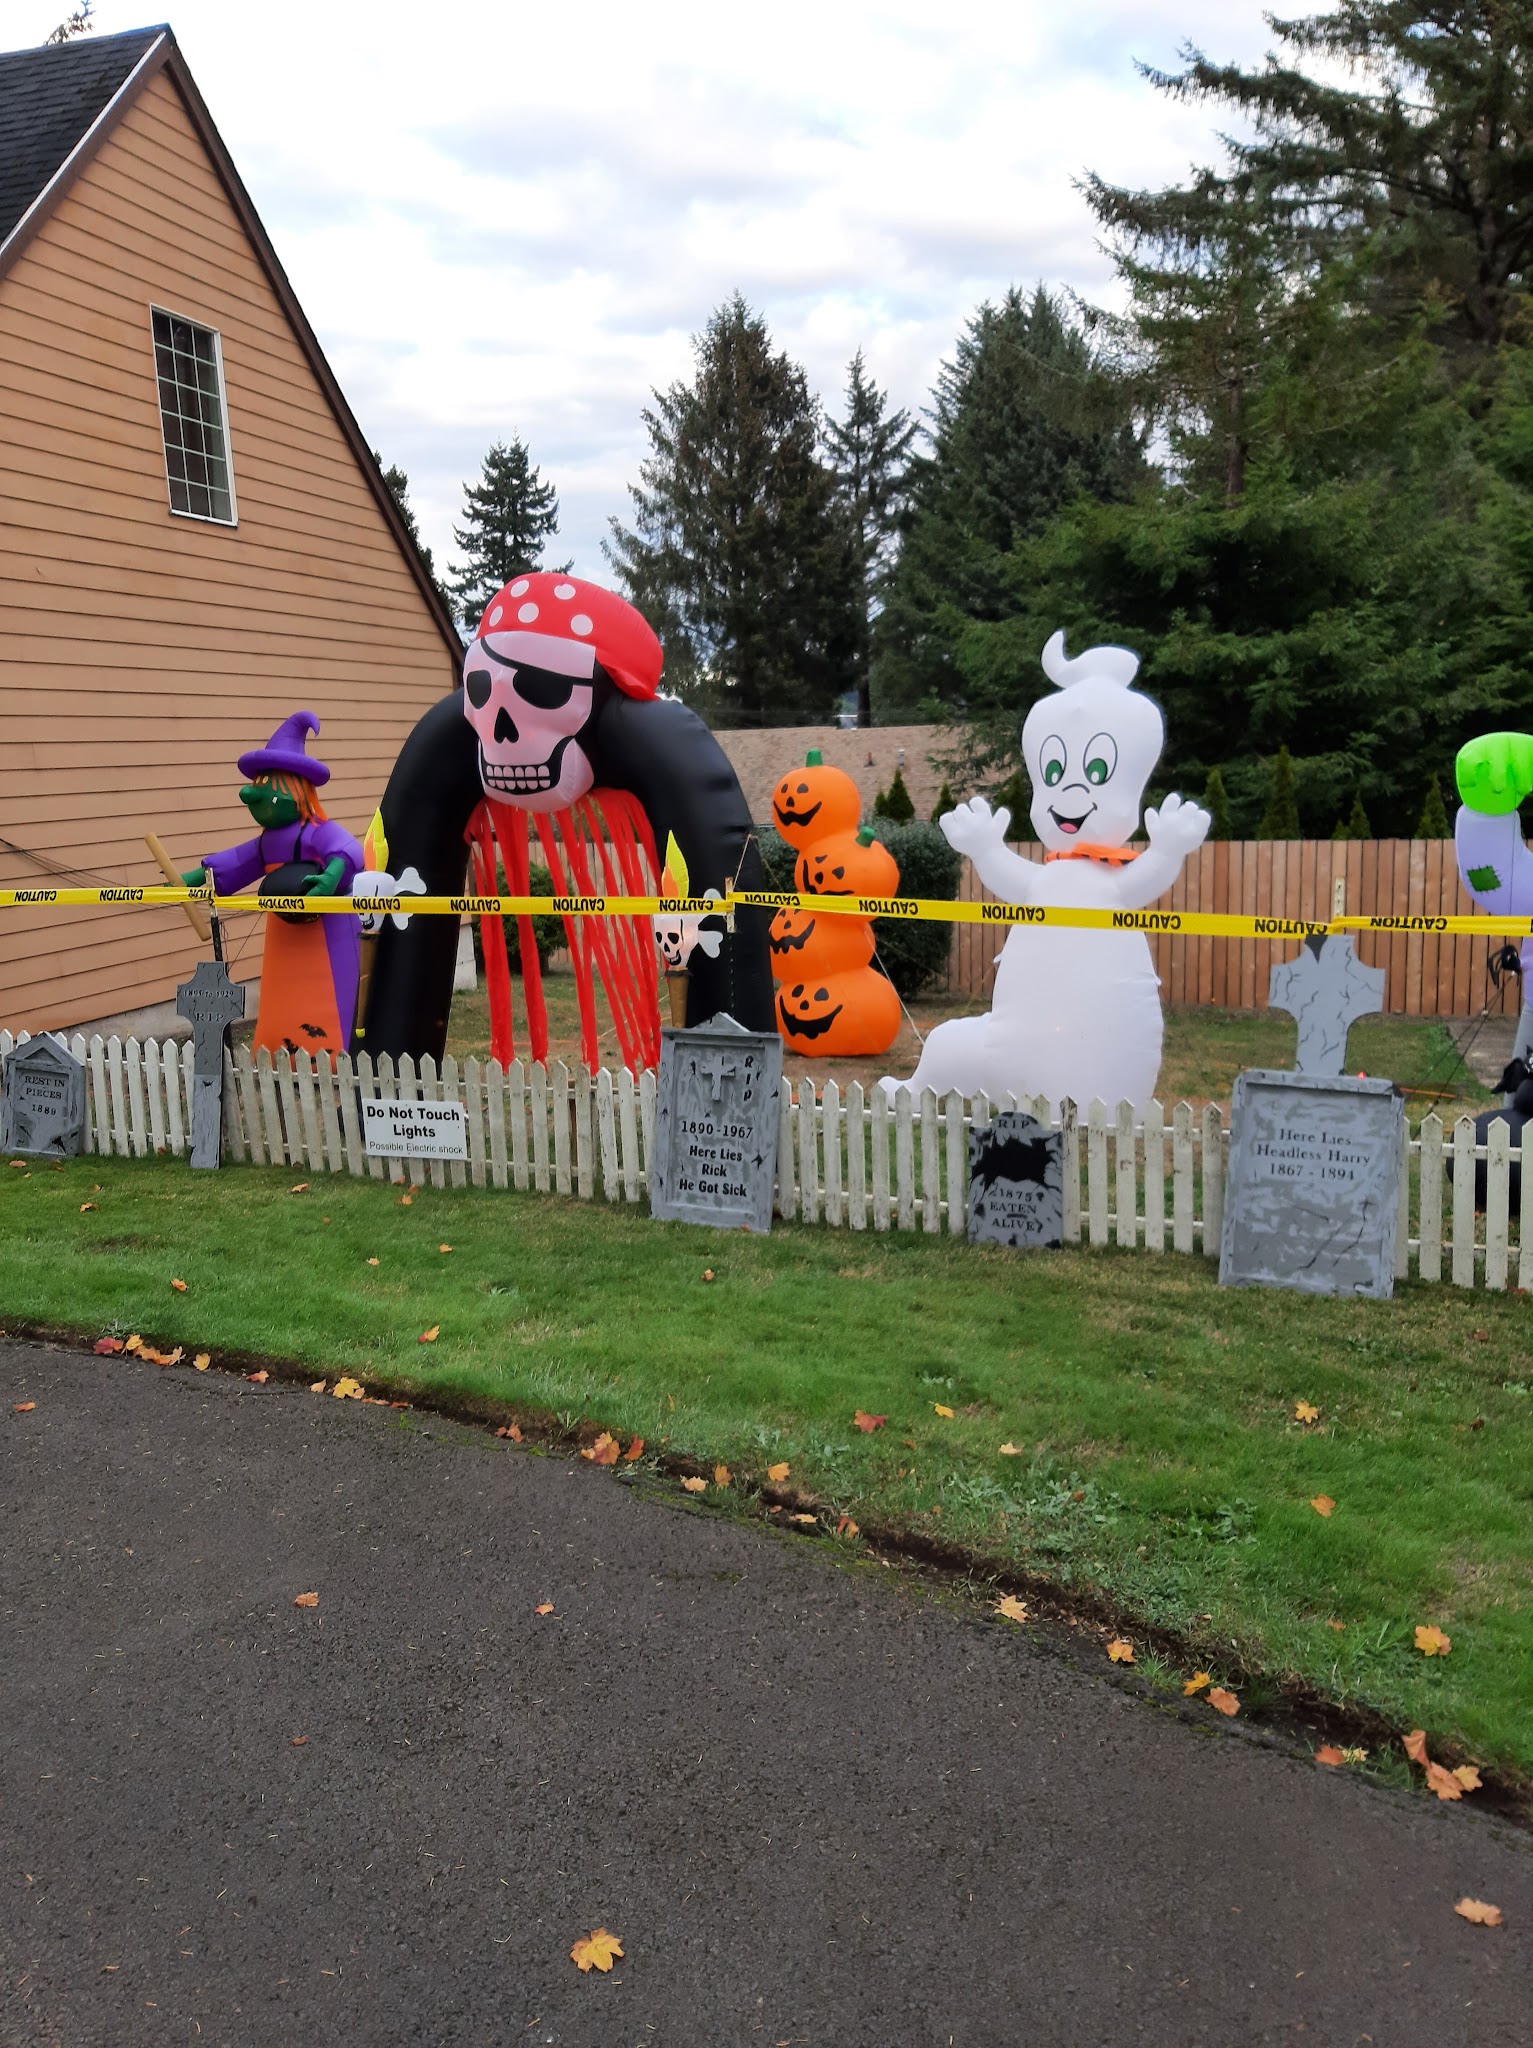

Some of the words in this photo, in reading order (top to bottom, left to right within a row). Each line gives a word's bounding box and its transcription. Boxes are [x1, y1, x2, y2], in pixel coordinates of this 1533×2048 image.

[14, 890, 57, 902] CAUTION
[99, 889, 143, 902] CAUTION
[744, 894, 800, 906] CAUTION
[258, 897, 305, 911] CAUTION
[352, 898, 401, 911] CAUTION
[450, 898, 501, 912] CAUTION
[552, 898, 605, 912] CAUTION
[659, 899, 714, 912] CAUTION
[858, 899, 919, 915] CAUTION
[982, 905, 1046, 922] CAUTION
[1112, 912, 1182, 930] CAUTION
[1254, 918, 1329, 935] CAUTION
[1370, 917, 1448, 931] CAUTION
[24, 1075, 51, 1086] REST
[53, 1079, 65, 1088] IN
[26, 1087, 62, 1100] PIECES
[366, 1105, 385, 1118] Do
[389, 1106, 414, 1119] Not
[417, 1107, 460, 1121] Touch
[393, 1124, 436, 1139] Lights
[1279, 1128, 1316, 1143] Here
[1322, 1132, 1351, 1145] Lies
[369, 1141, 404, 1151] Possible
[406, 1142, 437, 1153] Electric
[689, 1145, 717, 1159] Here
[720, 1148, 743, 1162] Lies
[1256, 1144, 1322, 1161] Headless
[1328, 1150, 1371, 1167] Harry
[701, 1163, 728, 1178] Rick
[1269, 1162, 1304, 1177] 1867
[679, 1179, 695, 1191] He
[698, 1180, 718, 1195] Got
[722, 1183, 748, 1197] Sick
[990, 1201, 1037, 1215] EATEN
[992, 1218, 1035, 1232] ALIVE
